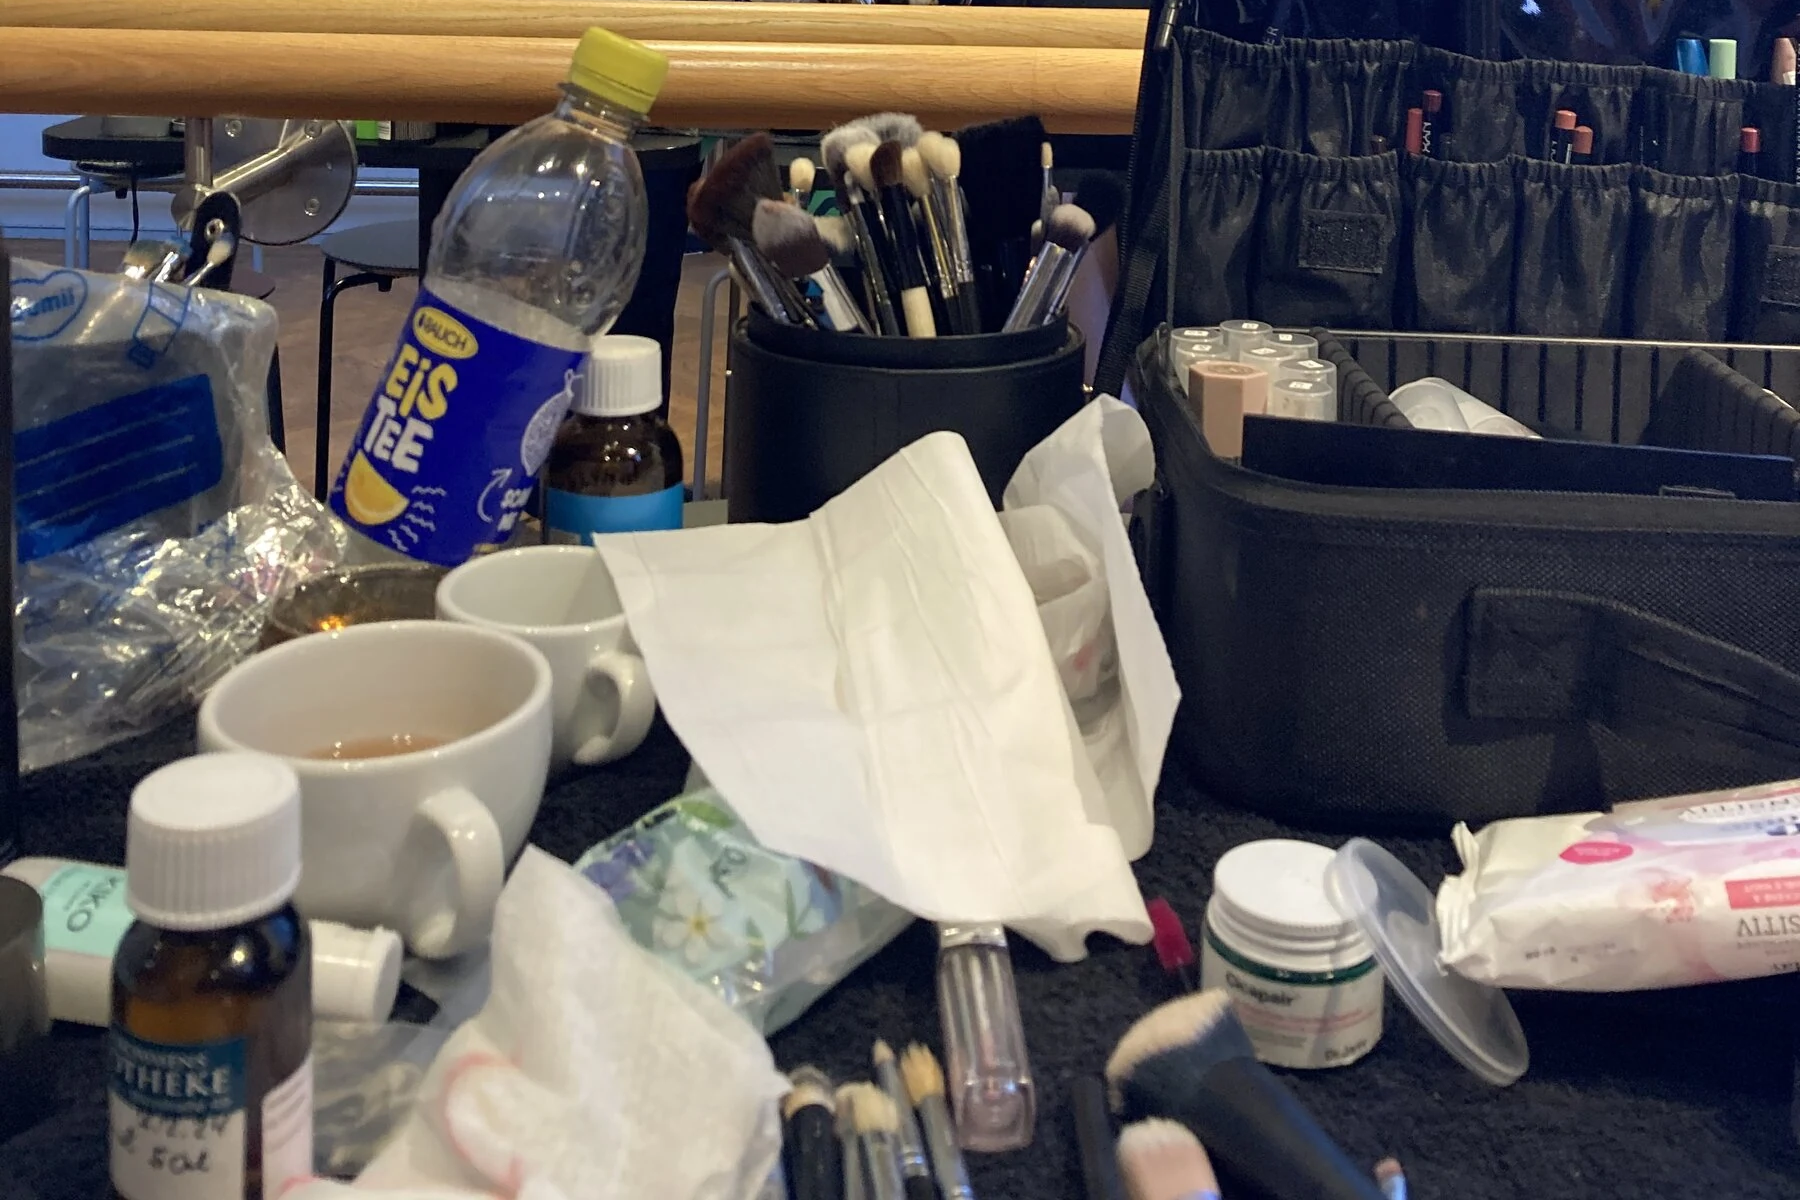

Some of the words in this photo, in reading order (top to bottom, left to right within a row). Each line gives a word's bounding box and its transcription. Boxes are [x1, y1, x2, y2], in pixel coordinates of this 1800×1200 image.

[418, 312, 469, 352] RAUCH
[363, 394, 434, 473] TEE
[1225, 970, 1293, 1006] Cicapair
